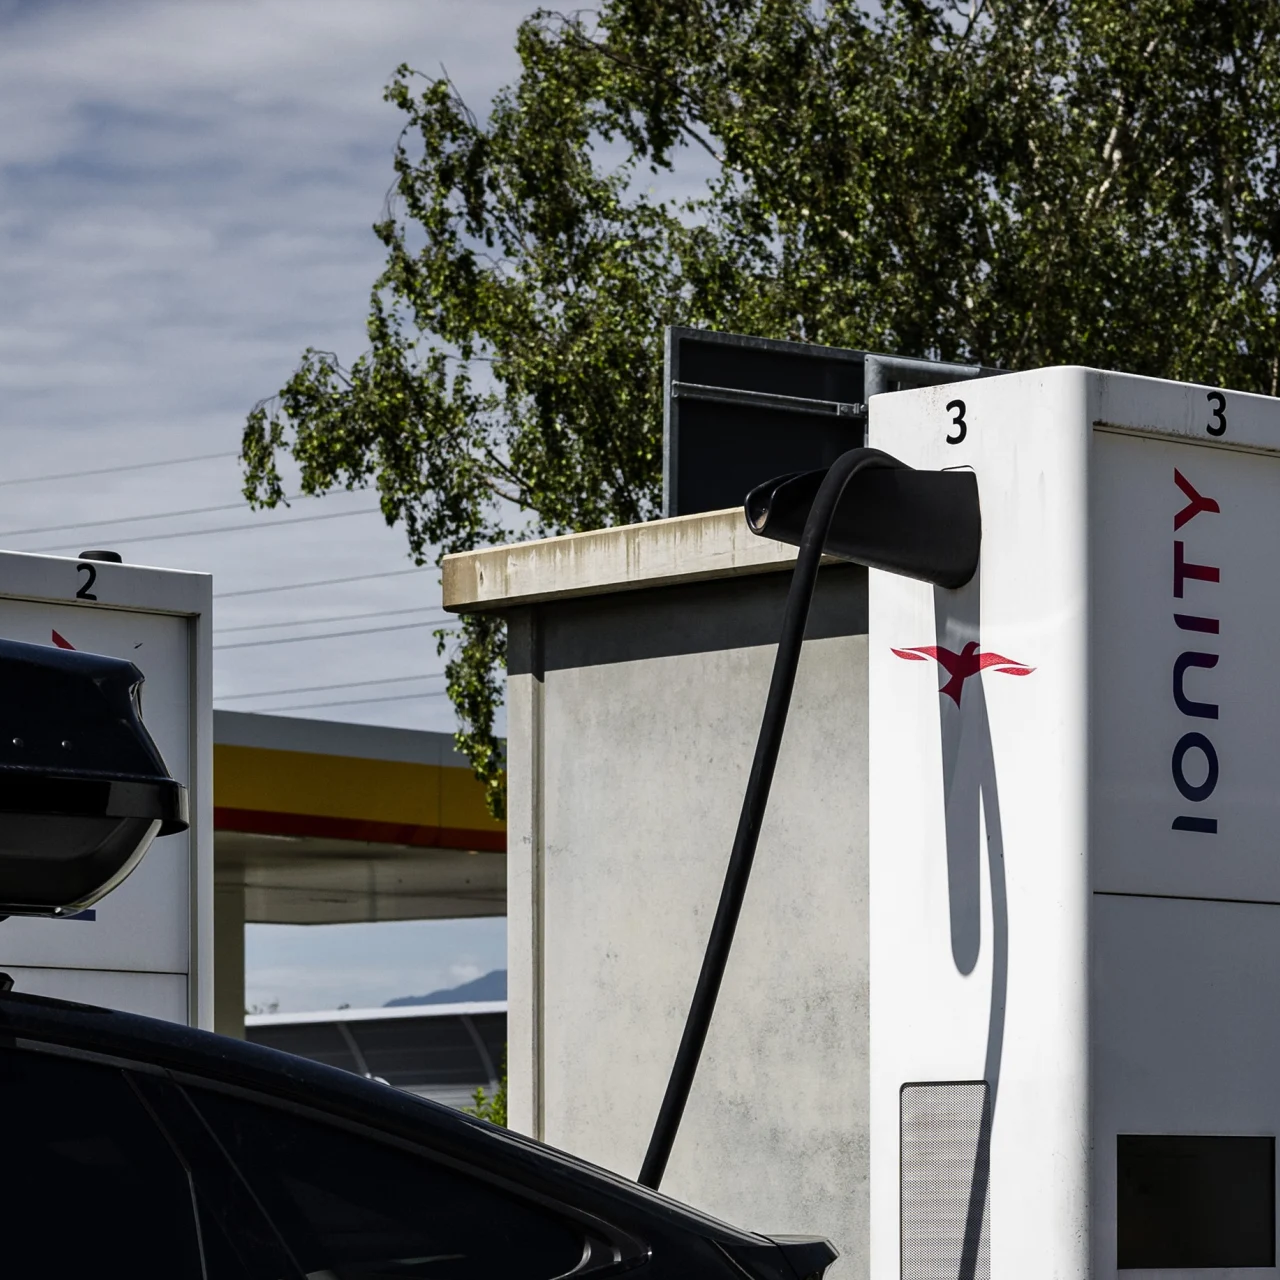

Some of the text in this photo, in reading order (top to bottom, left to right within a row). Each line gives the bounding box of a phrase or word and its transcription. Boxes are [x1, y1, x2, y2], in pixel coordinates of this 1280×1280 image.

[945, 399, 968, 445] 3
[1206, 391, 1227, 437] 3
[76, 562, 98, 601] 2
[1171, 466, 1221, 835] IONITY
